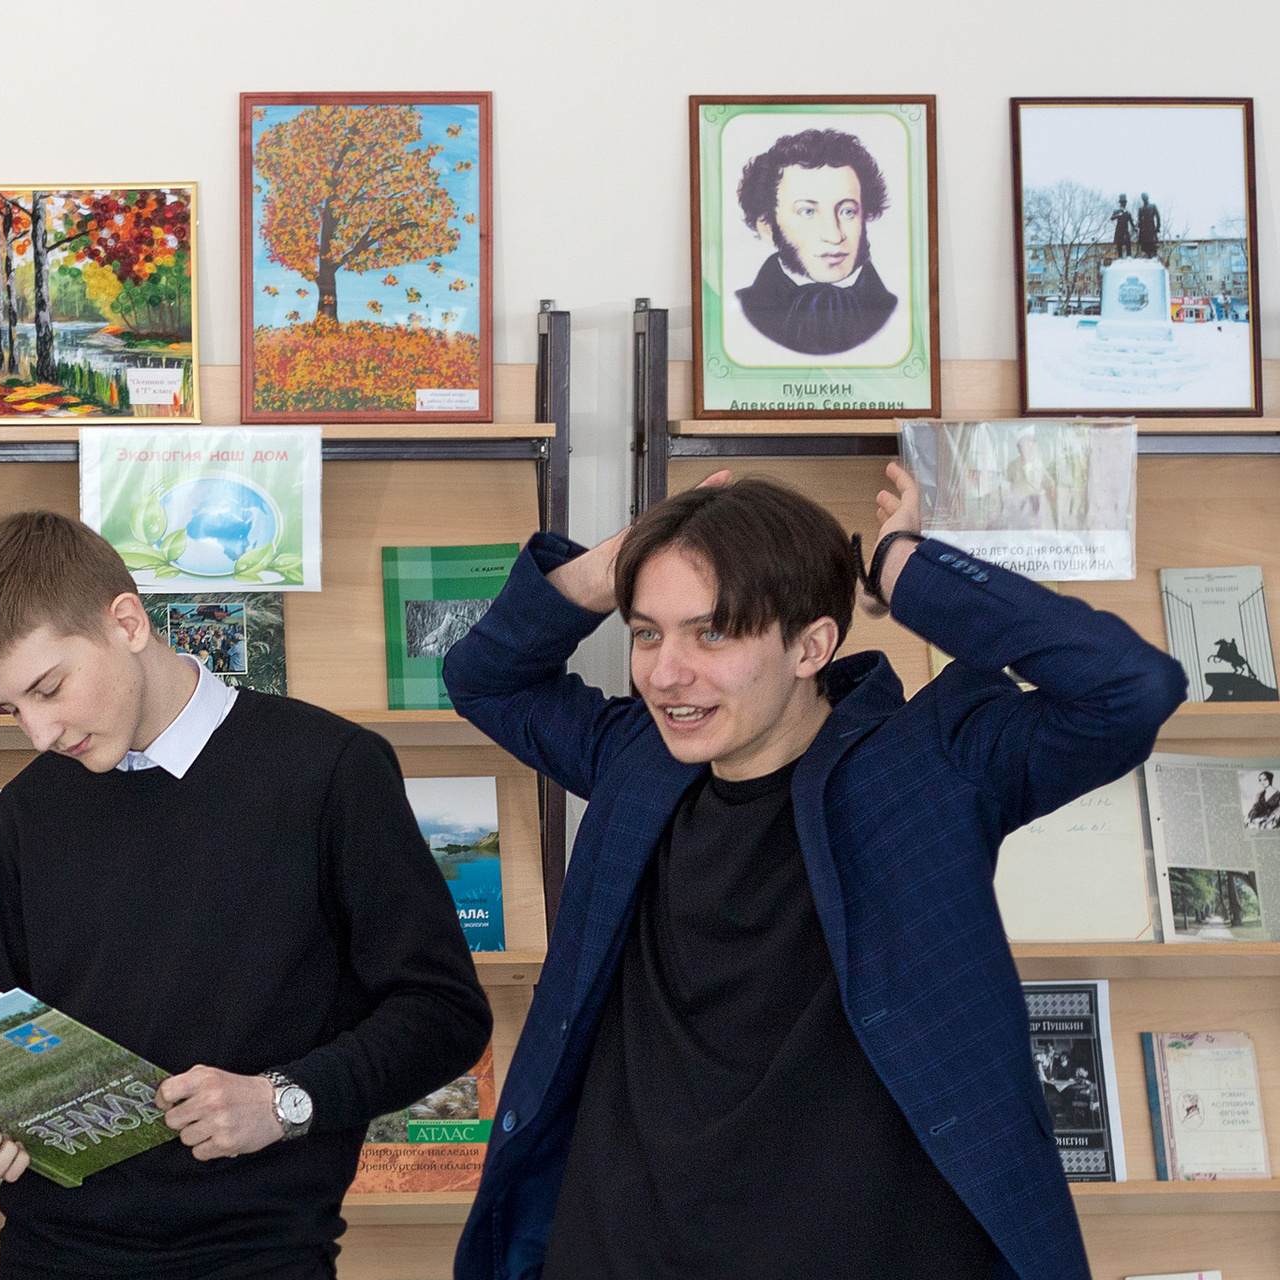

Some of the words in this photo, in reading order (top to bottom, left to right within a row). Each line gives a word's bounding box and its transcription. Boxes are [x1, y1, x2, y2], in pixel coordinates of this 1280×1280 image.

[782, 383, 853, 397] ПУШКИН
[729, 400, 816, 410] Александр
[823, 399, 905, 410] Сергеевич
[116, 448, 201, 463] Экология
[210, 449, 245, 462] наш
[252, 450, 289, 463] дом
[970, 547, 987, 556] 220
[989, 547, 1009, 556] ЛЕТ
[1010, 547, 1025, 555] СО
[1026, 546, 1048, 557] ДНЯ
[1049, 546, 1106, 556] РОЖДЕНИЯ
[1053, 559, 1114, 571] ПУШКИНА
[457, 908, 489, 920] АЛА:
[26, 1080, 157, 1146] ЗЕМЛЯ
[85, 1101, 165, 1145] ЛЮД
[416, 1127, 475, 1141] АТЛАС
[428, 1148, 479, 1156] наследия
[440, 1160, 484, 1171] области
